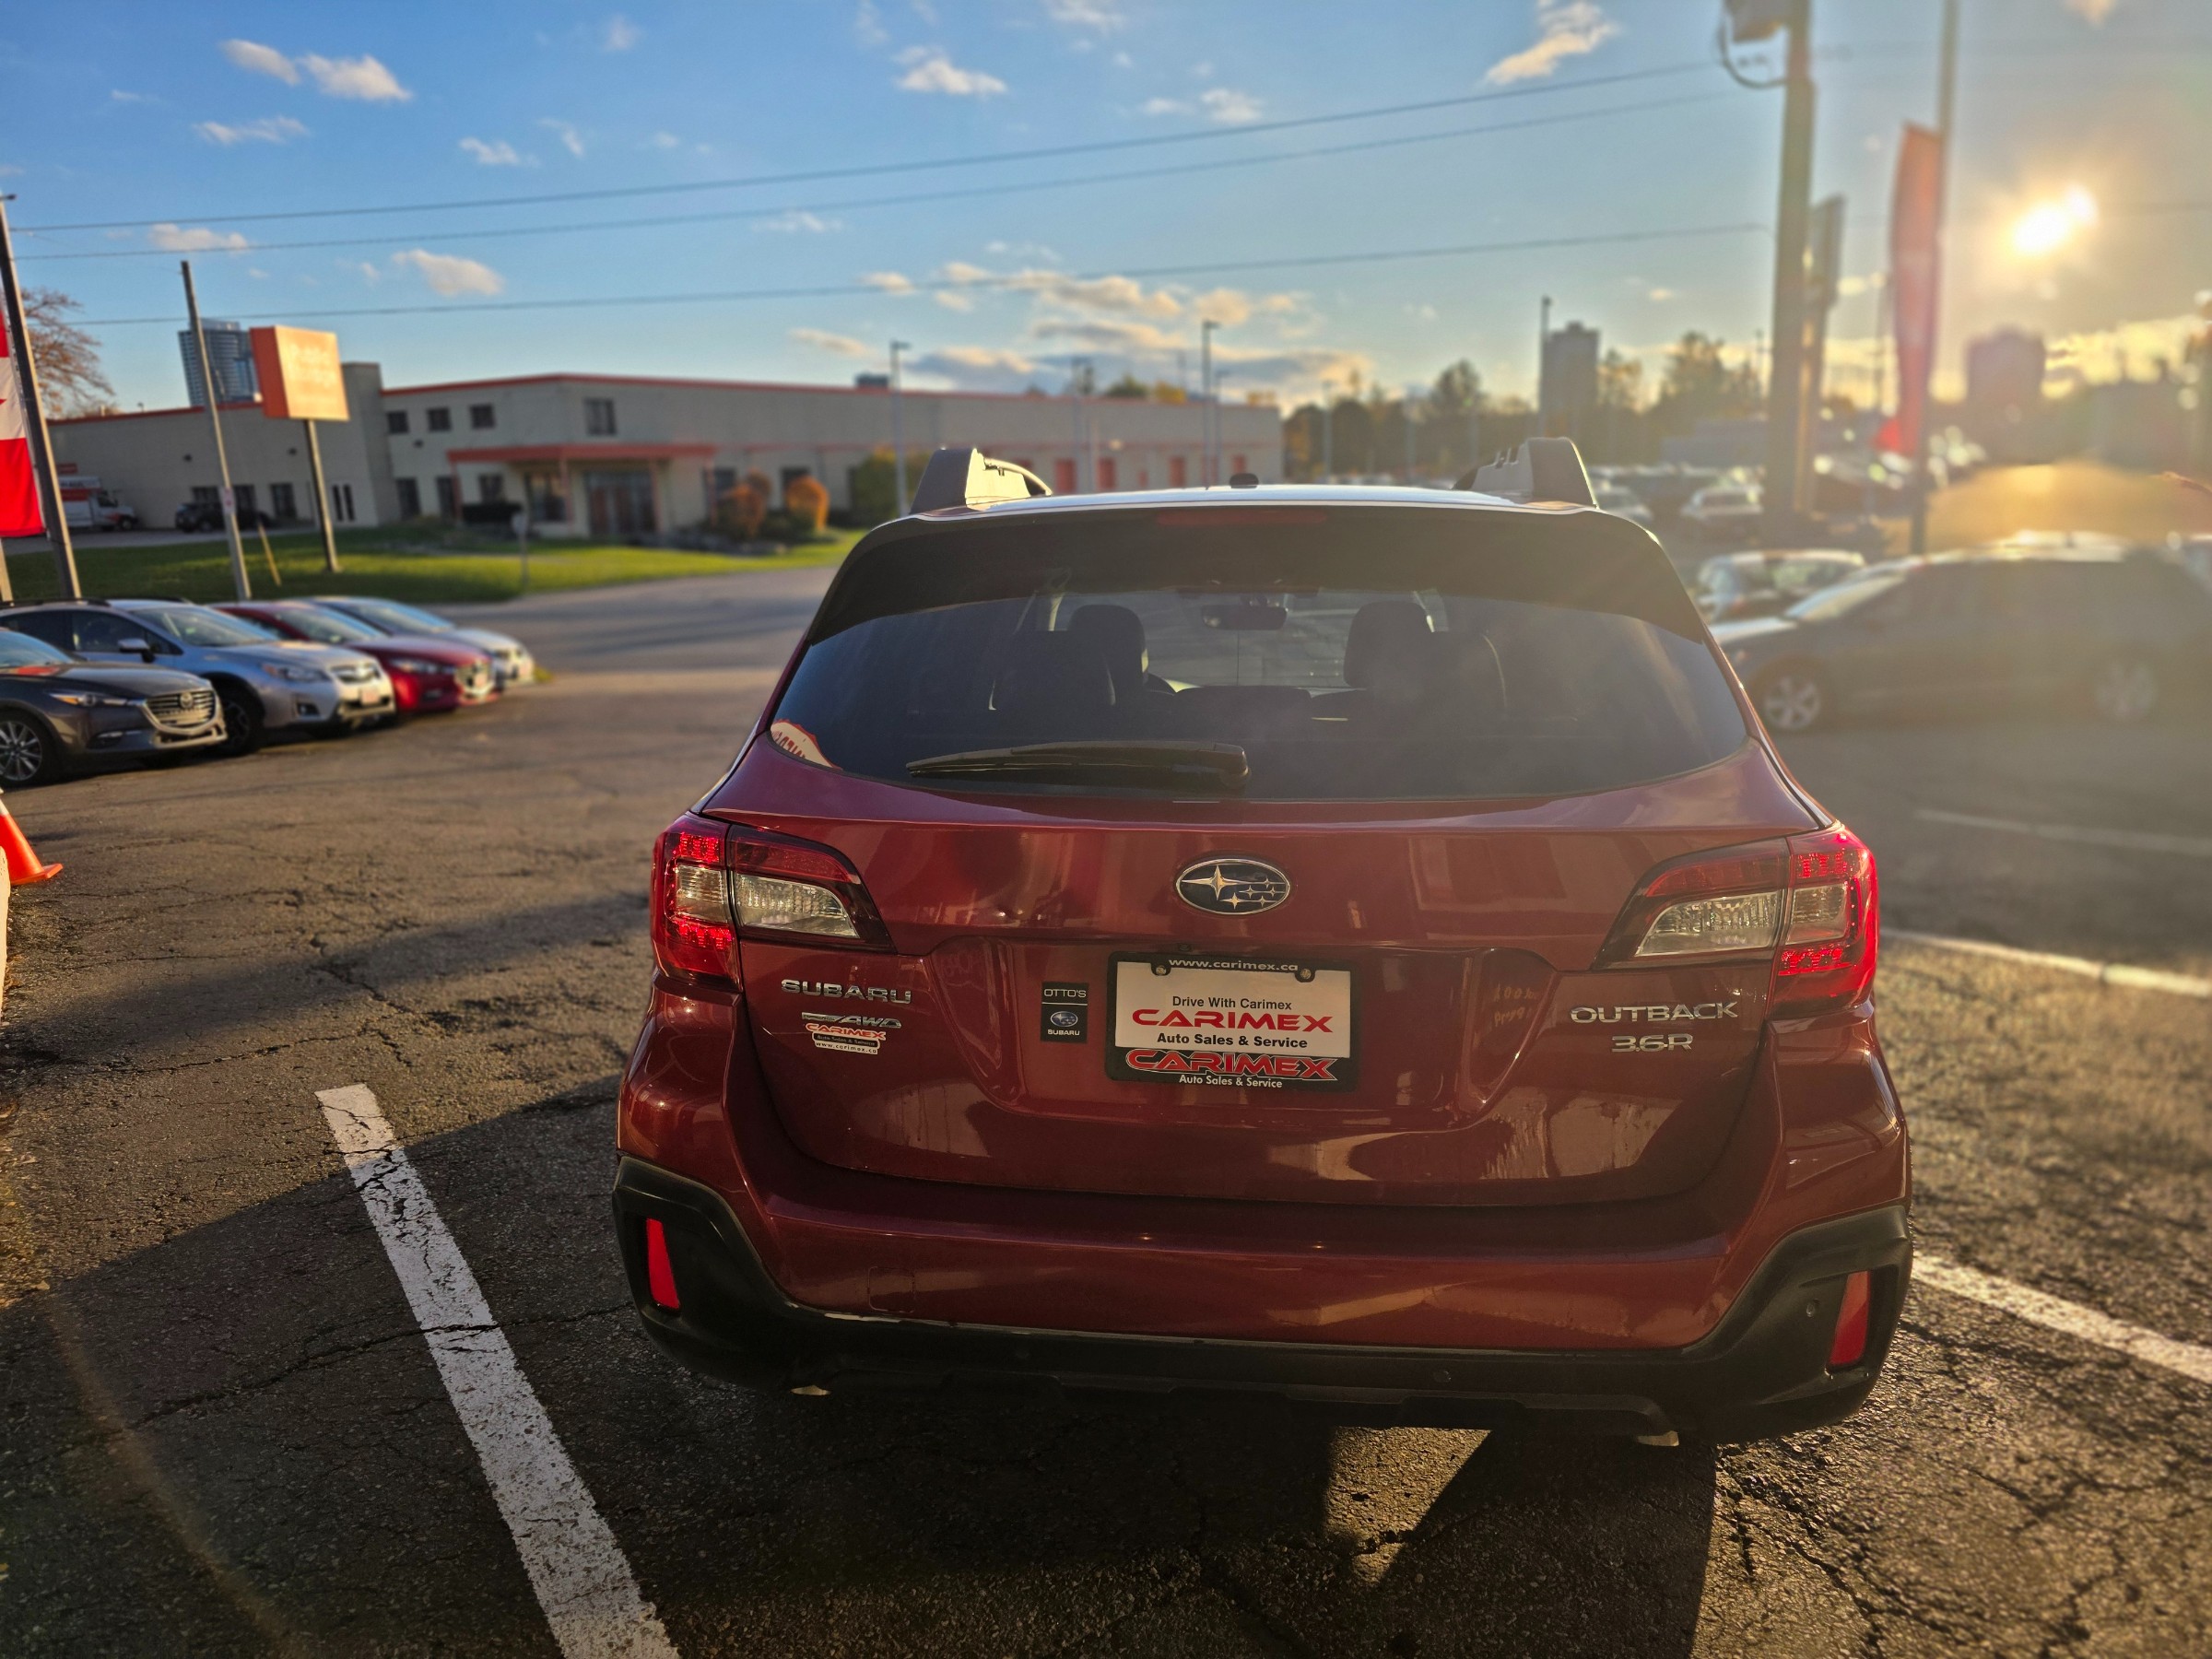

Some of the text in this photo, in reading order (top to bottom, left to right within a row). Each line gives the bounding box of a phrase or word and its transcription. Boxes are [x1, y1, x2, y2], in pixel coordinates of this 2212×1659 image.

[1168, 959, 1299, 971] www.carimex.ca
[781, 979, 912, 1005] SUBARU
[1043, 988, 1087, 998] OTTO'S
[1172, 995, 1292, 1011] Drive With Carimex
[1132, 1008, 1334, 1033] CARIMEX
[1571, 1001, 1738, 1024] OUTBACK
[839, 1015, 902, 1029] AWD
[806, 1023, 886, 1039] CARIMEX
[1157, 1032, 1308, 1049] Auto Sales & Service
[1126, 1049, 1337, 1081] CARIMEX
[1179, 1074, 1283, 1088] Auto Sales & Service
